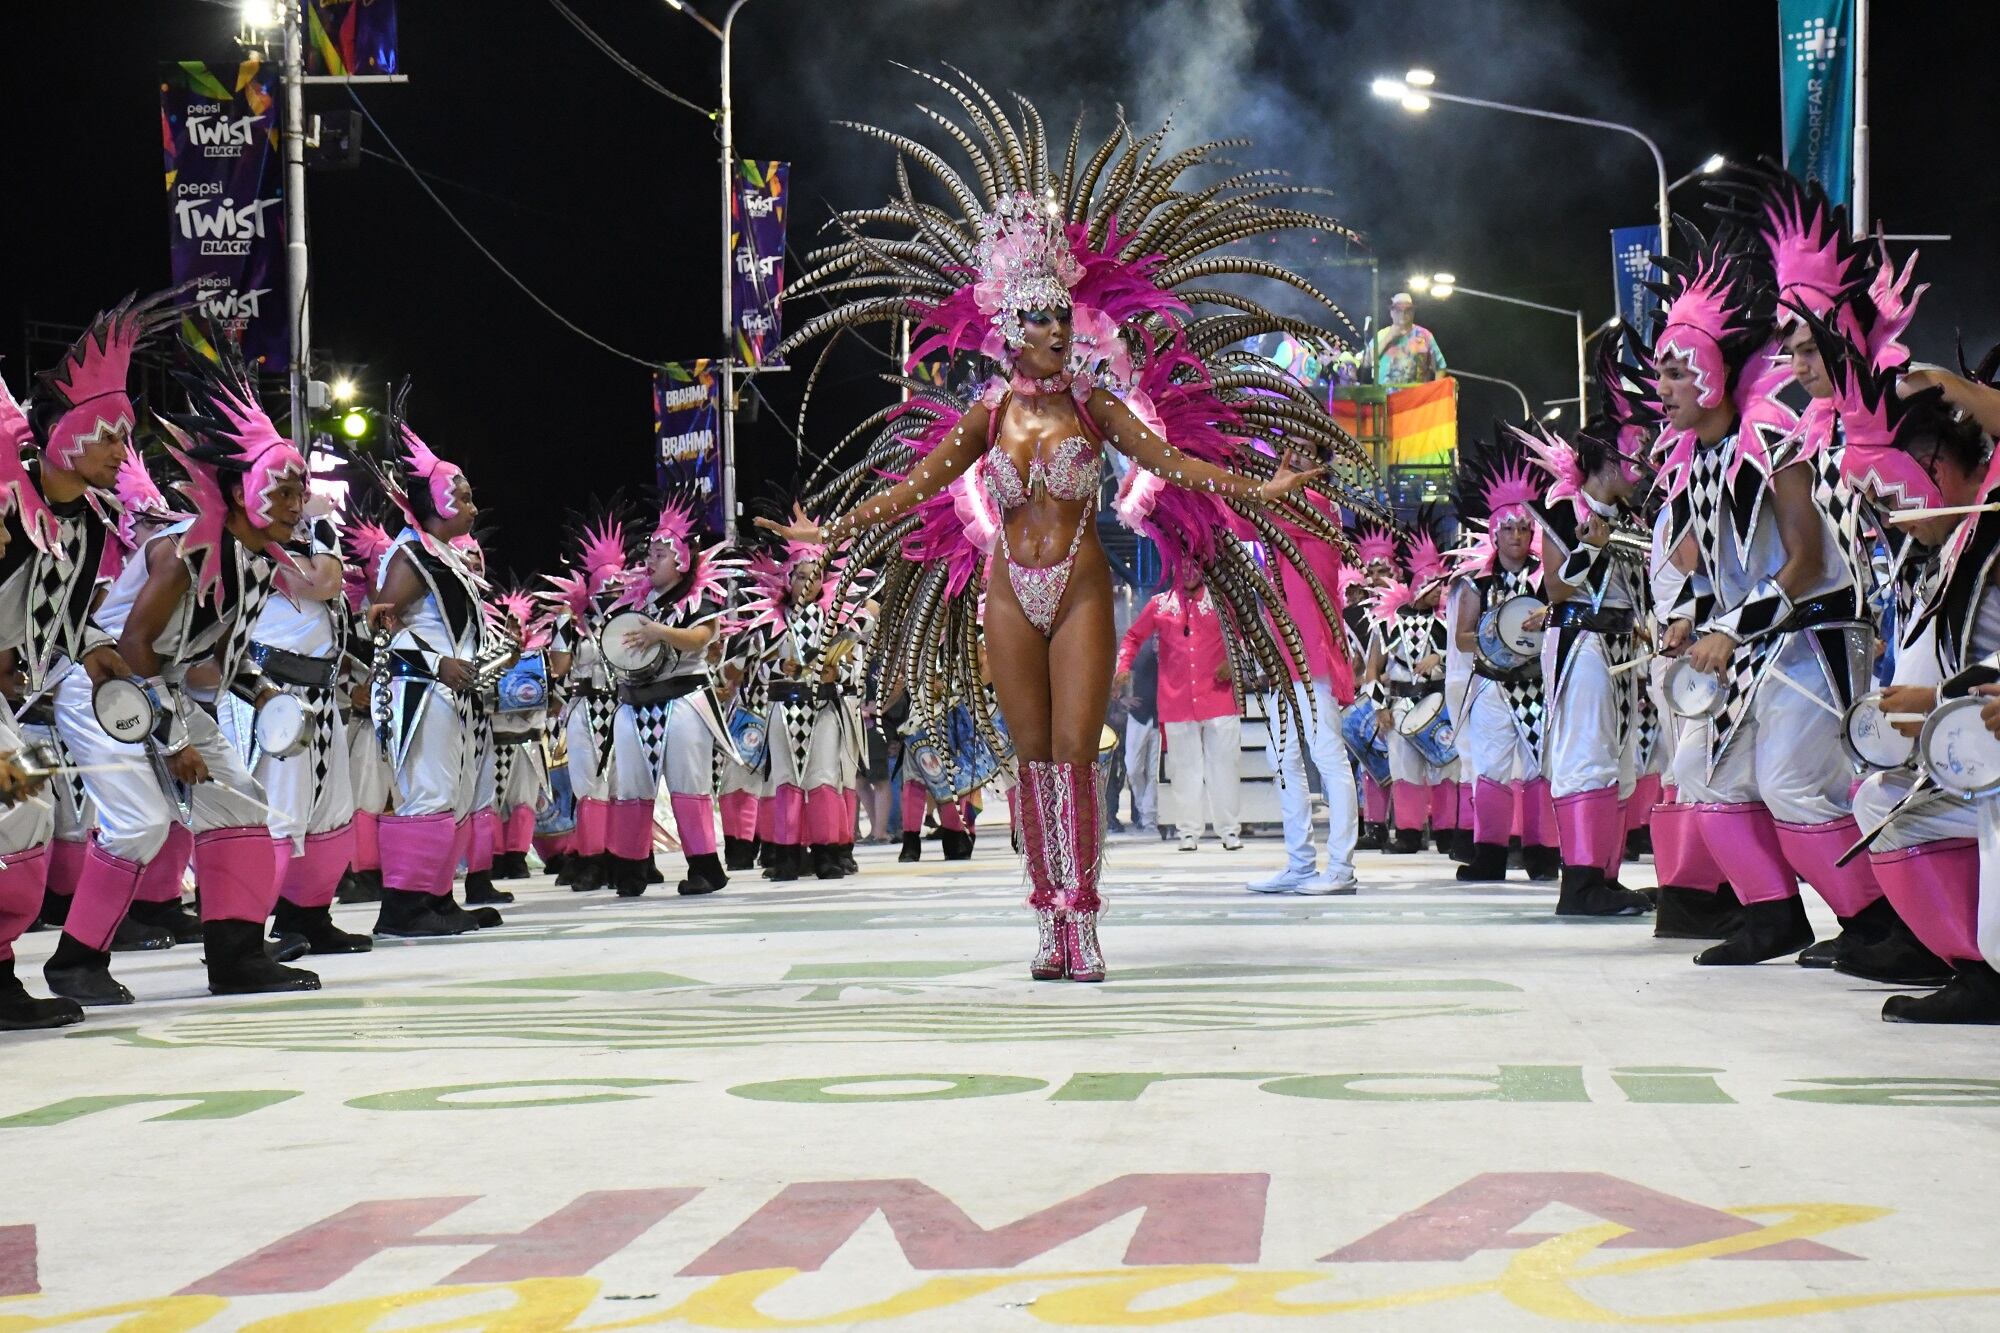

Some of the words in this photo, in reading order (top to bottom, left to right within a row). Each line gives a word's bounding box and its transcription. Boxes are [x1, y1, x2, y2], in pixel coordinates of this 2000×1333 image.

[187, 103, 221, 115] pepsi
[204, 146, 242, 157] BLACK
[177, 181, 223, 198] pepsi
[201, 241, 251, 255] BLACK
[665, 384, 708, 407] BRAHMA
[662, 429, 714, 457] BRAHMA
